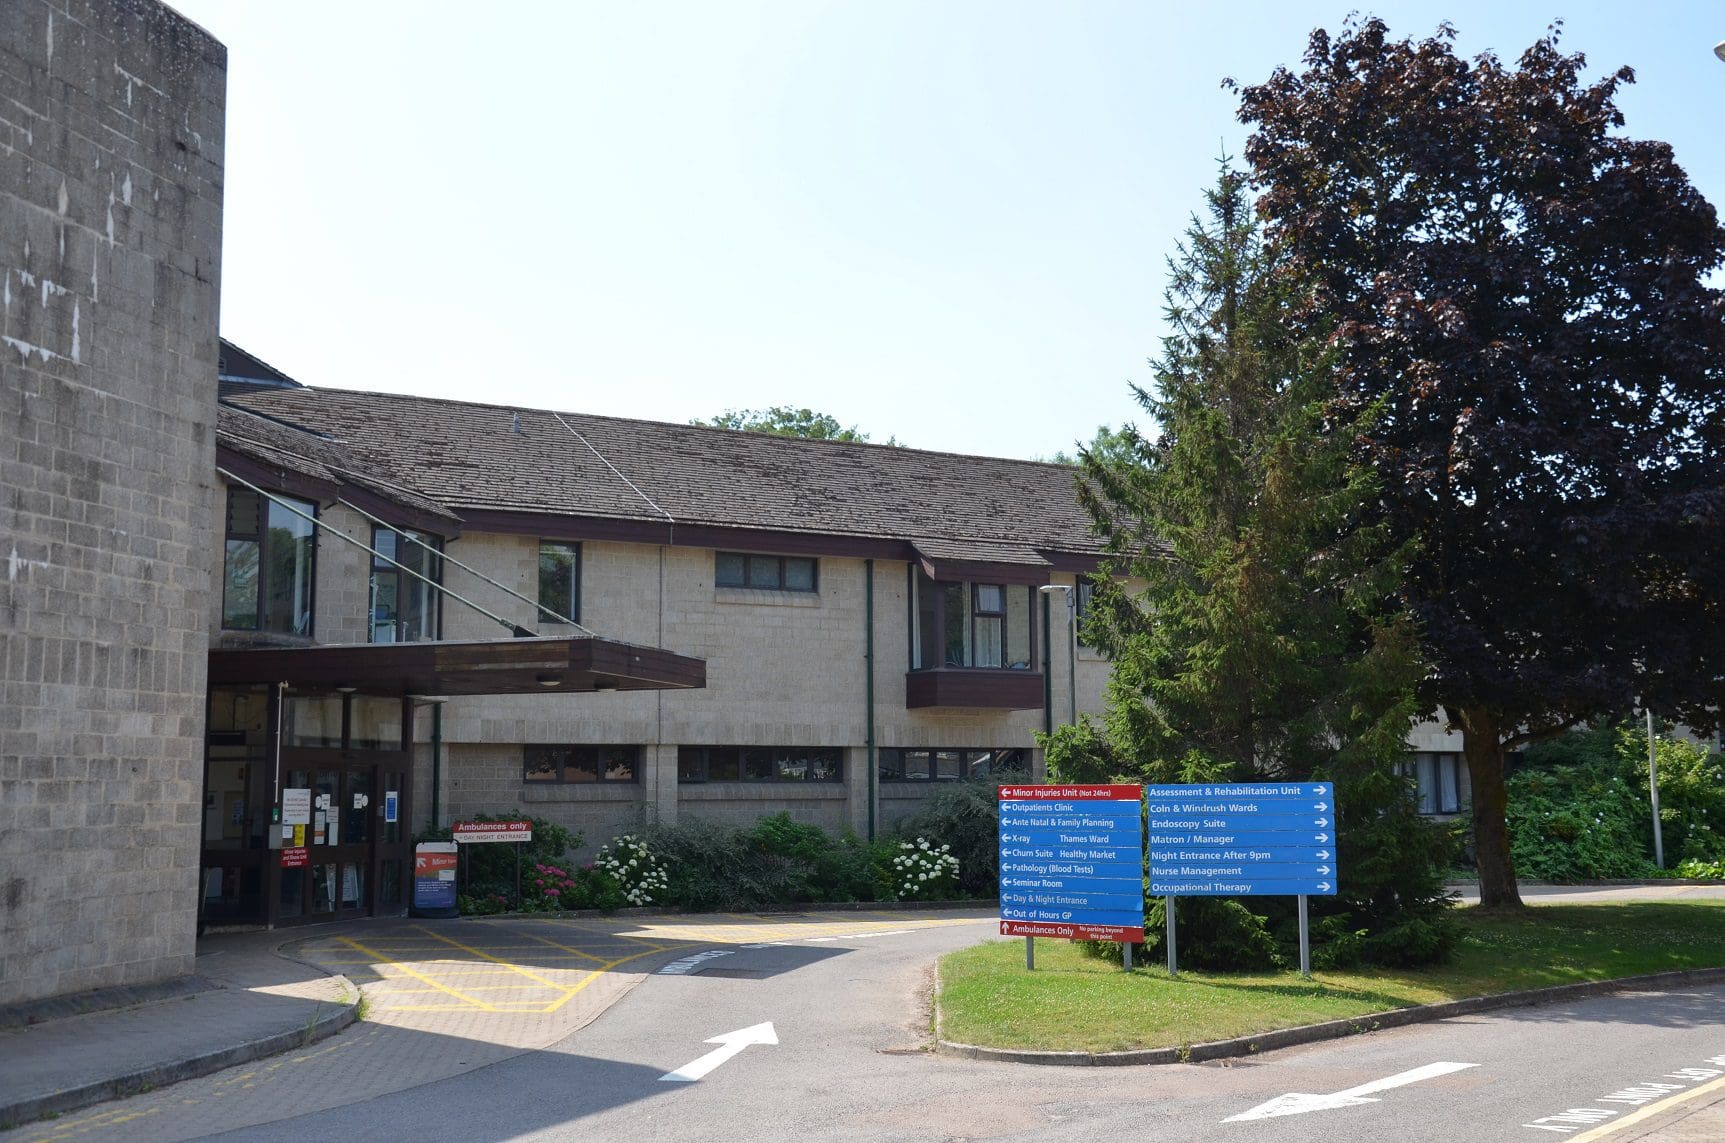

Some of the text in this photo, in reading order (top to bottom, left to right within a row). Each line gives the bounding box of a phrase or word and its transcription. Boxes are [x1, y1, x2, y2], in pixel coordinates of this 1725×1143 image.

[1035, 789, 1060, 798] Injuries
[1150, 787, 1301, 796] Assessment & Rehabilitation Unit
[1012, 804, 1052, 812] Outpatients
[1150, 804, 1258, 813] Coln & Windrush Wards
[1031, 818, 1048, 826] Natal
[1058, 819, 1080, 828] Family
[1083, 819, 1114, 828] Planning
[1152, 819, 1226, 829] Endoscopy Suite
[1012, 835, 1030, 843] X-ray
[1089, 835, 1109, 843] Ward
[1151, 835, 1184, 844] Matron
[1194, 835, 1234, 845] Manager
[1035, 849, 1053, 857] Suite
[1060, 851, 1116, 859] Healthy Market
[1152, 852, 1177, 861] Night
[1223, 851, 1247, 859] After
[1250, 851, 1270, 861] 9pm
[1013, 865, 1093, 874] Pathology (Blood Tests)
[1152, 867, 1242, 876] Nurse Management
[1152, 883, 1251, 893] Occupational Therapy
[1014, 895, 1026, 903] Day
[1036, 896, 1054, 904] Night
[1040, 911, 1059, 919] Hours
[1013, 925, 1073, 936] Ambulances Only
[1522, 1108, 1618, 1132] ONLY
